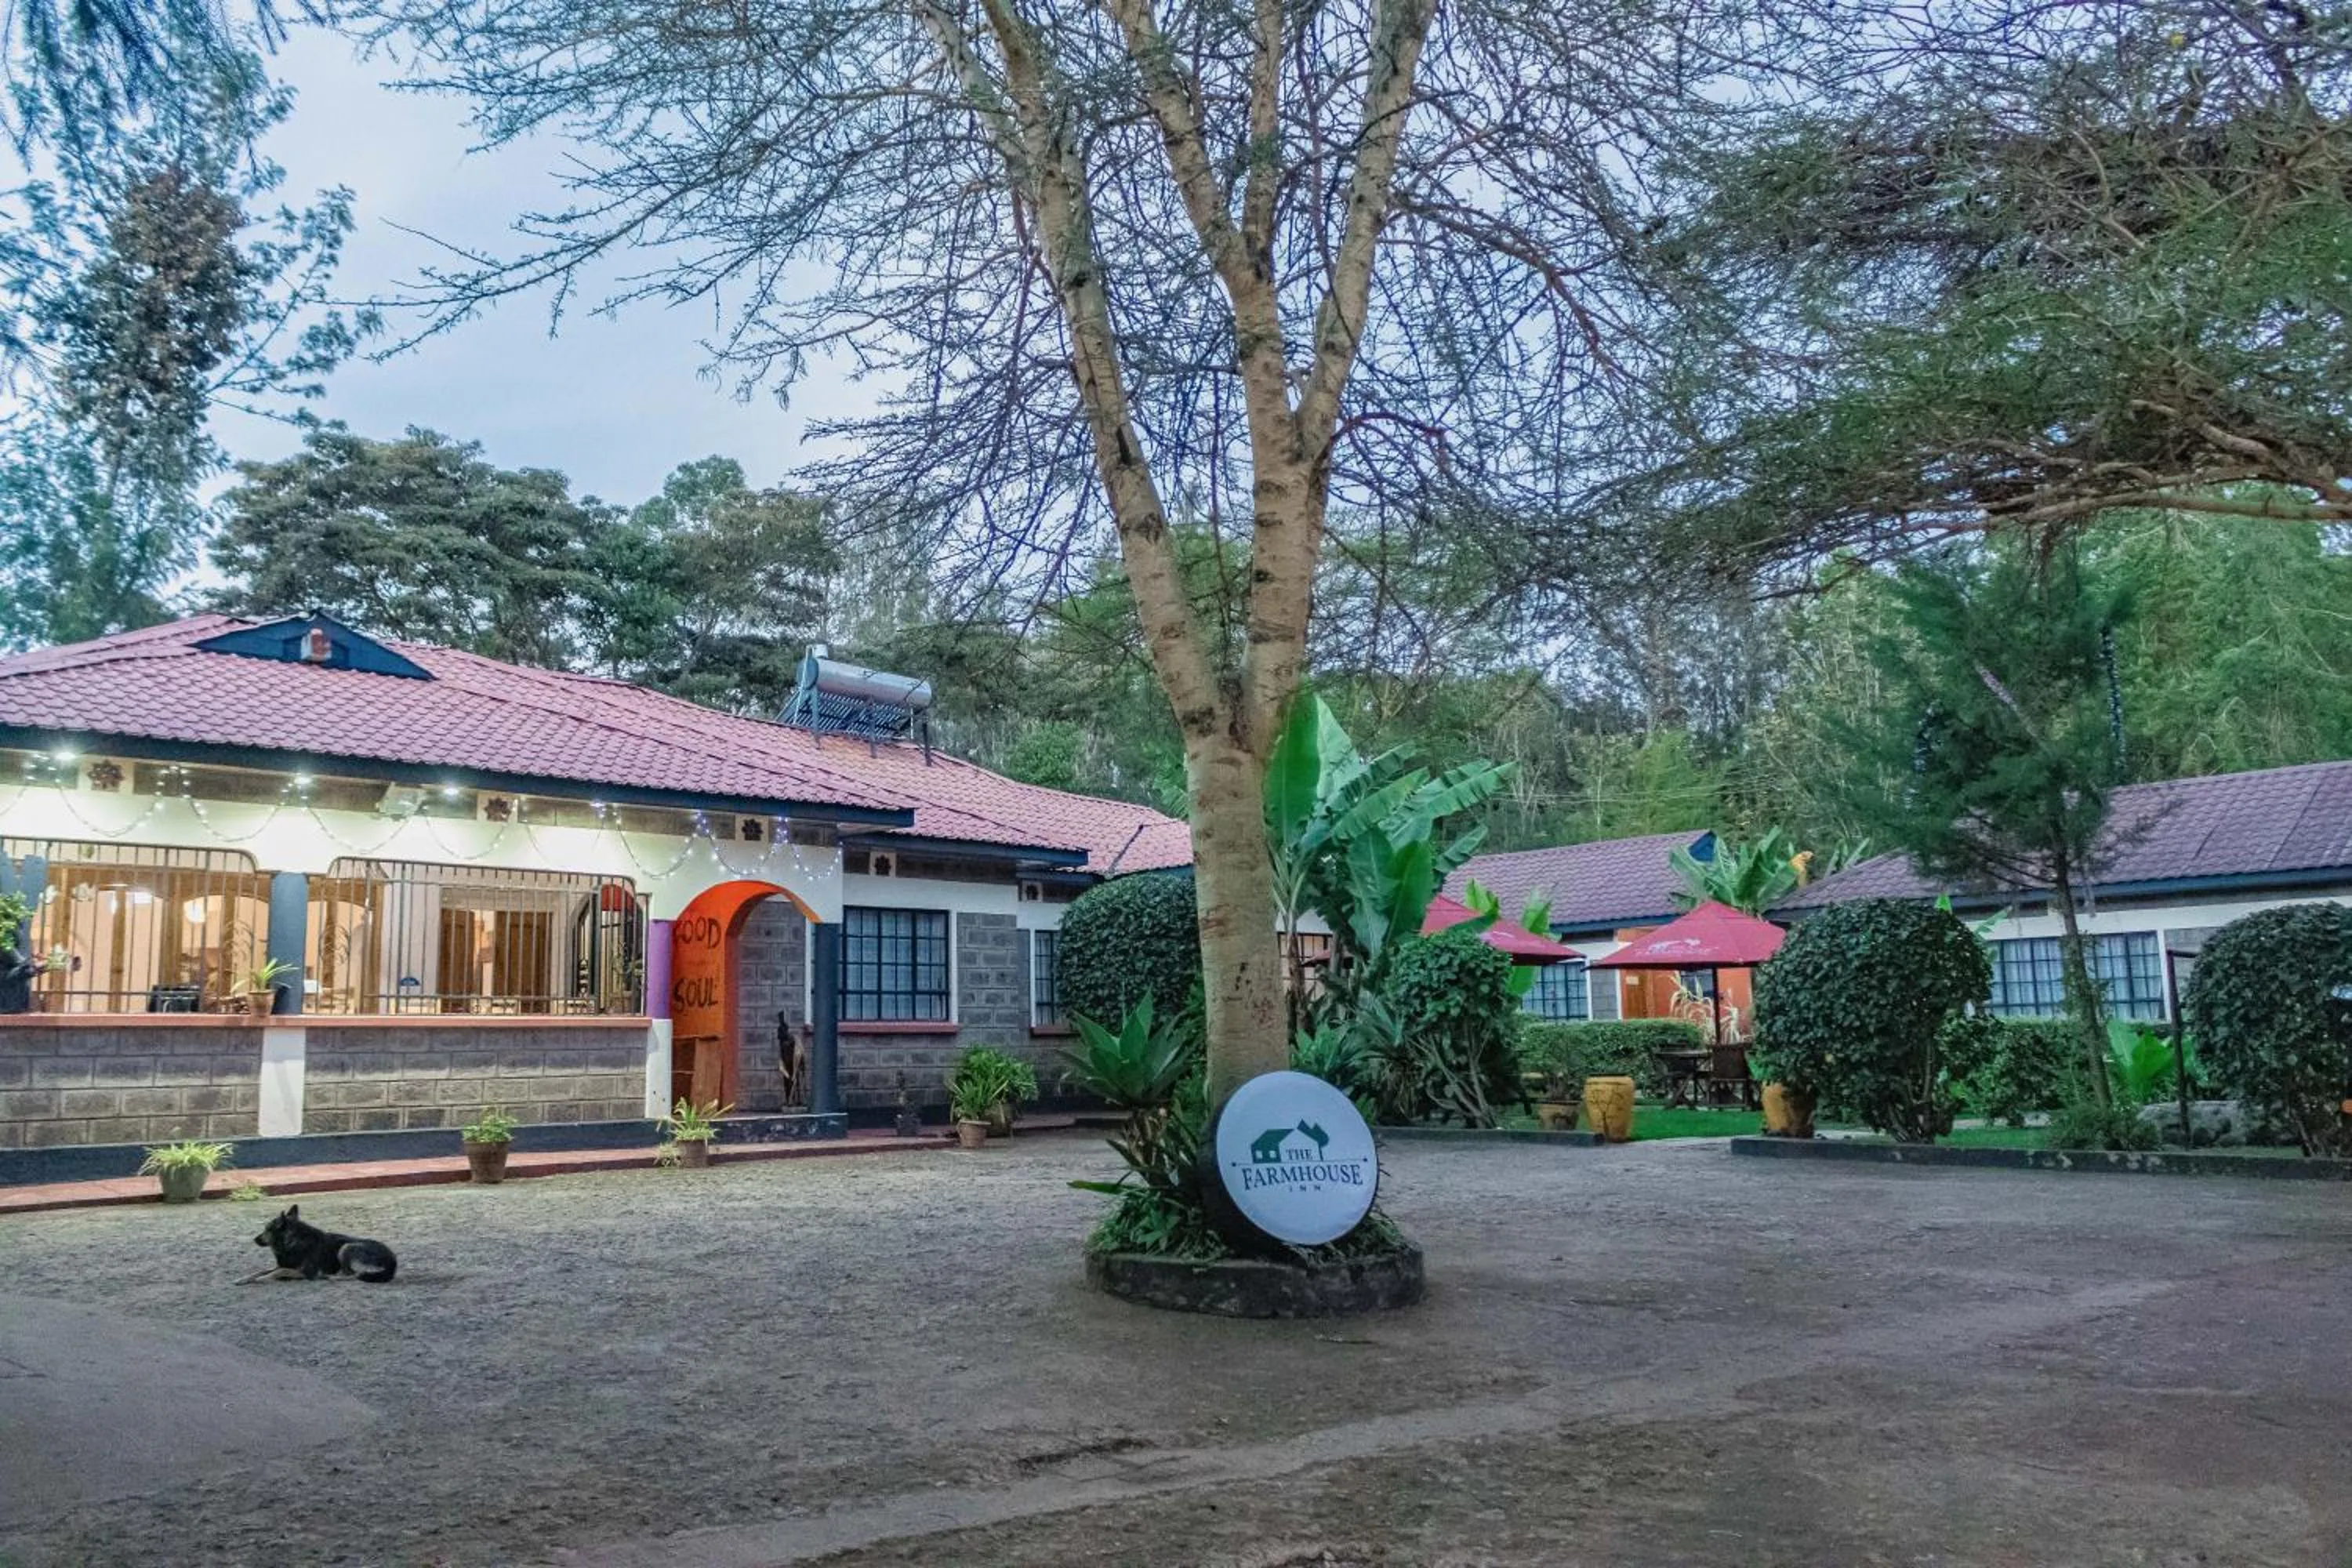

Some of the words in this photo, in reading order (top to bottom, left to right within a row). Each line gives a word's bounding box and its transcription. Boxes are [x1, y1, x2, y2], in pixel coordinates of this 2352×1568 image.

[672, 978, 718, 1013] SOUL
[1286, 1149, 1312, 1161] THE
[1242, 1164, 1363, 1191] FARMHOUSE
